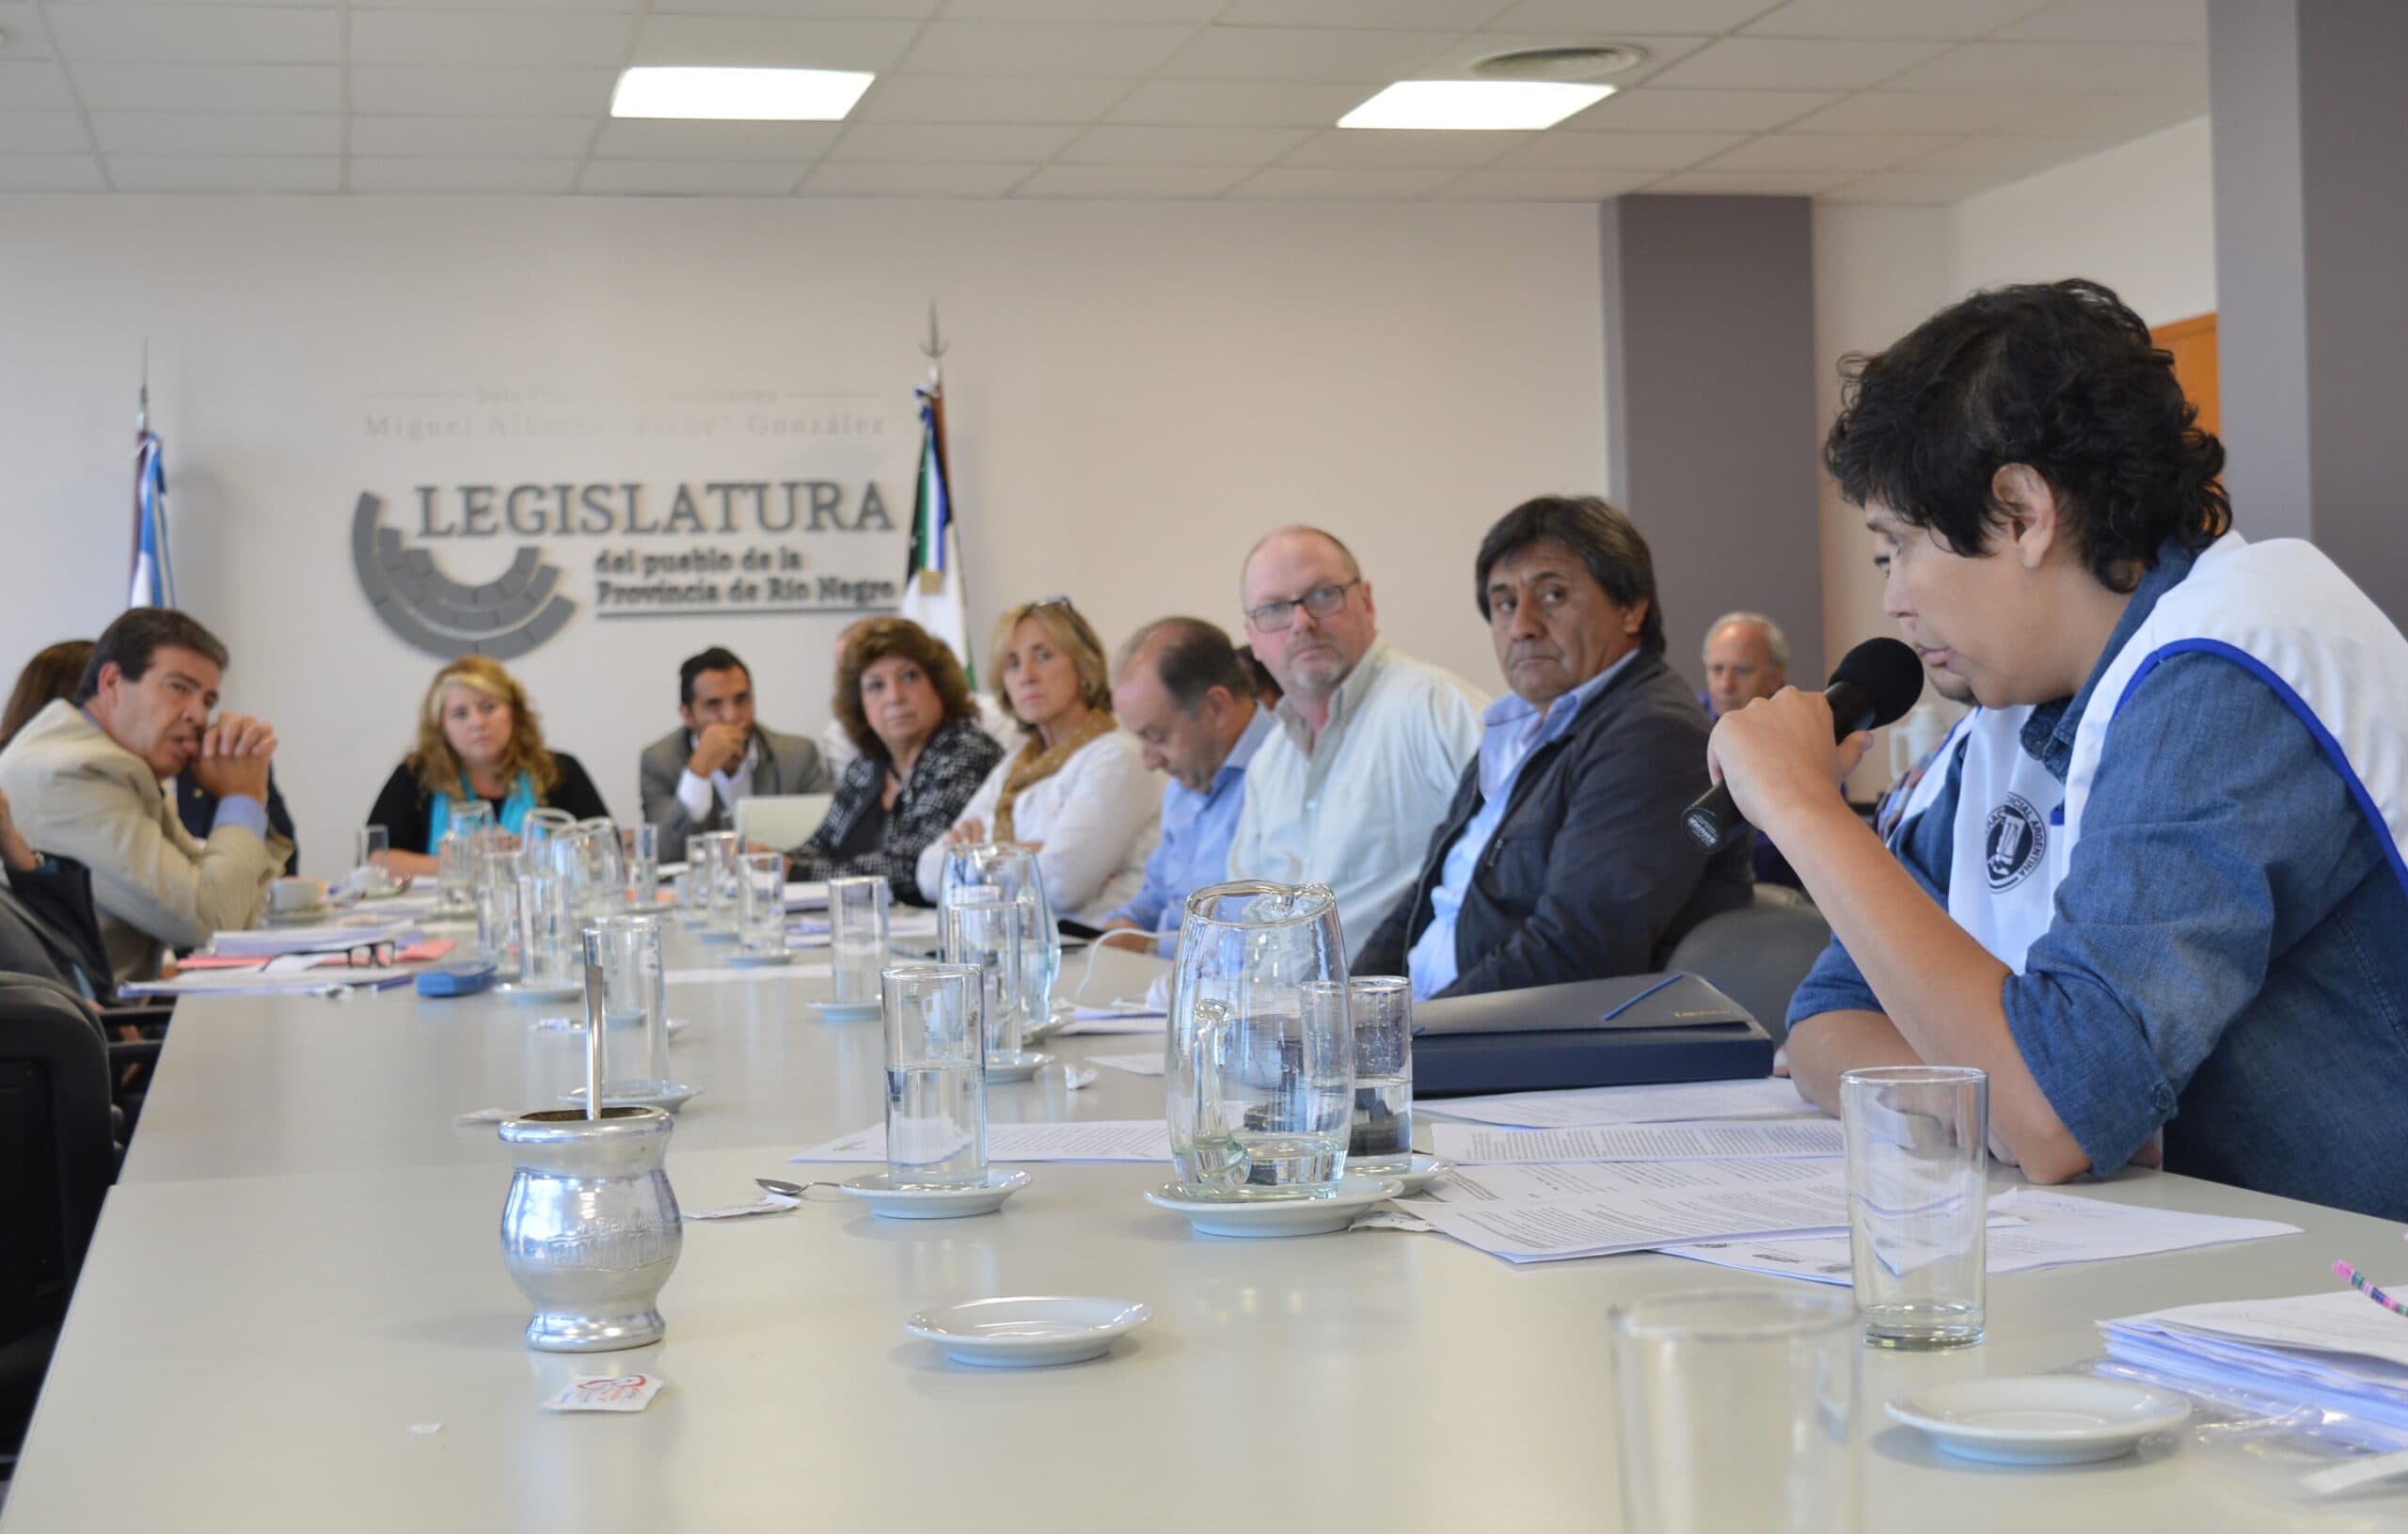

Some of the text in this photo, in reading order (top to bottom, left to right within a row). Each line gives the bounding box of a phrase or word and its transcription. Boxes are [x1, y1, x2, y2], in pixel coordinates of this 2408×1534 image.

[361, 414, 471, 442] Miguel
[414, 481, 895, 538] LEGISLATURA
[595, 546, 803, 577] del pueblo de la
[595, 579, 719, 604] Provincia
[728, 578, 759, 603] de
[816, 575, 897, 607] Negro
[2018, 820, 2043, 877] ARGENTINA
